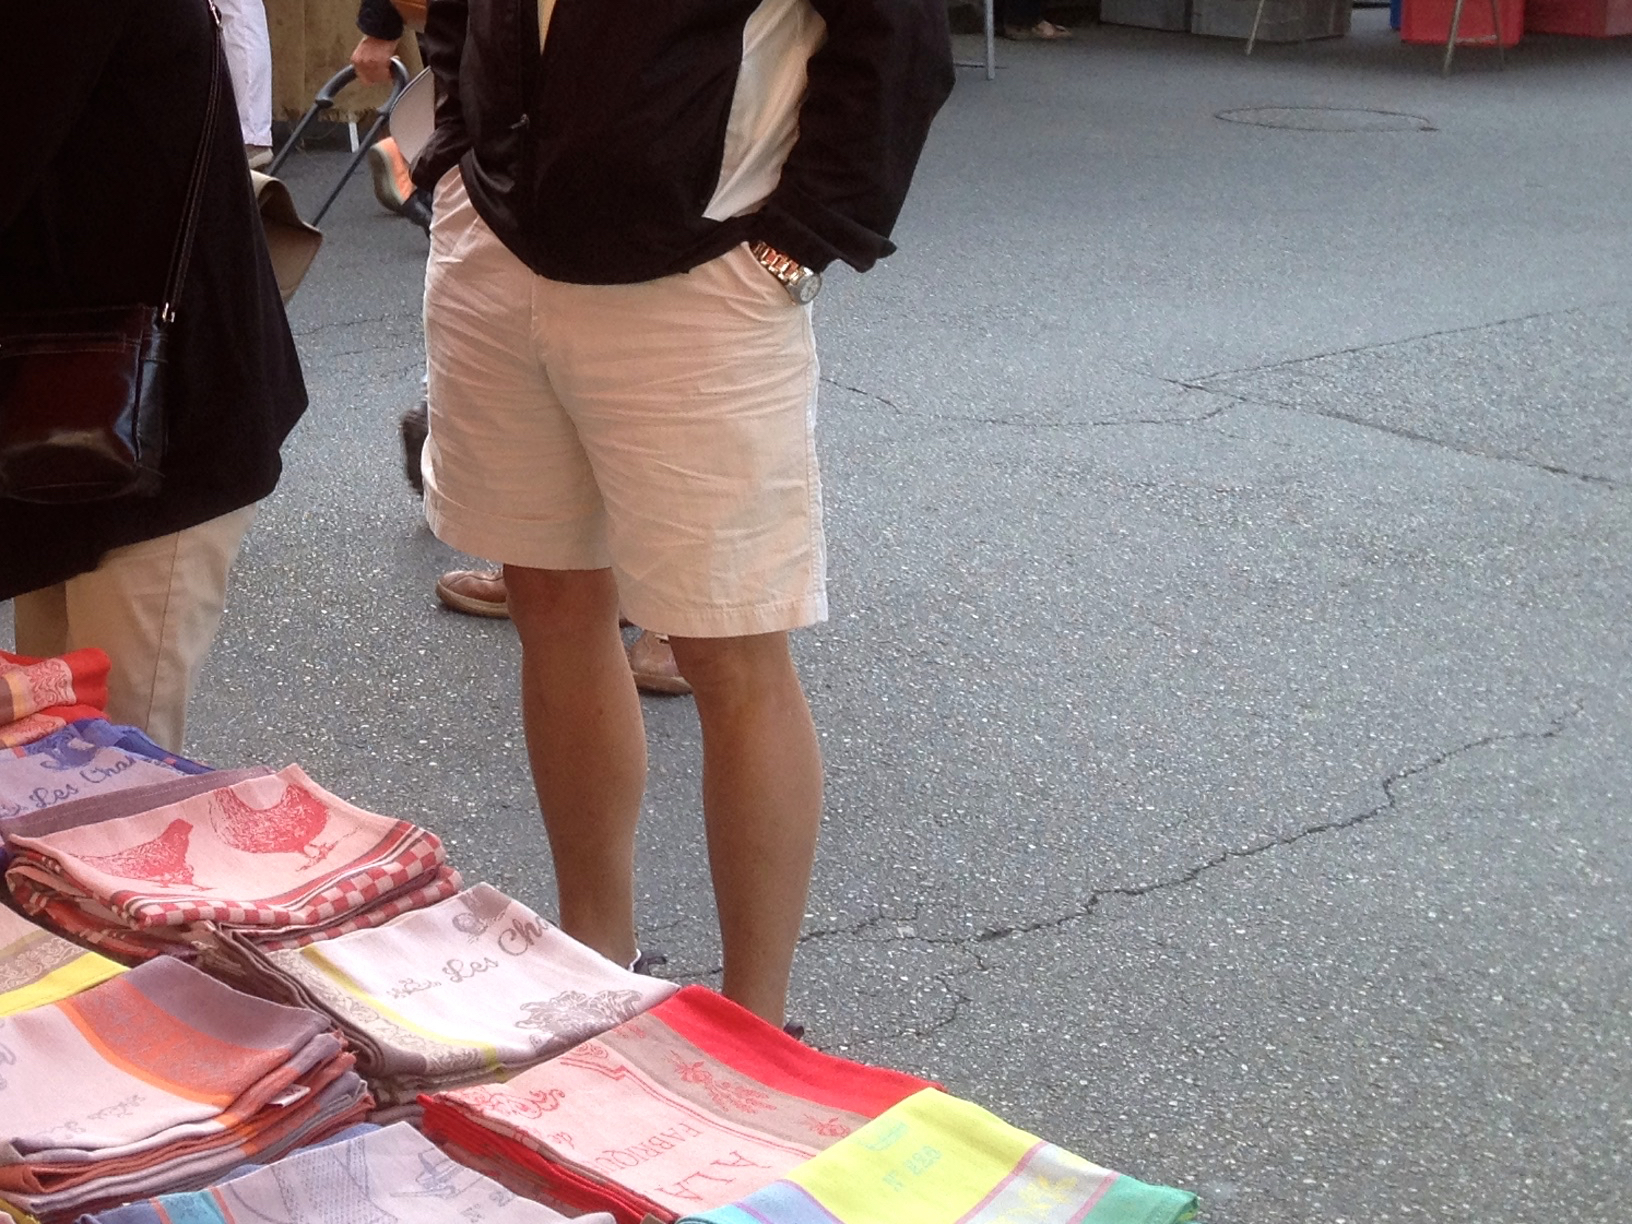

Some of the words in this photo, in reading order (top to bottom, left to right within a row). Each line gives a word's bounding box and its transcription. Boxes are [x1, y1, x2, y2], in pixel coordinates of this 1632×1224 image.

[29, 783, 79, 809] Les
[442, 957, 499, 983] Les
[654, 1171, 735, 1201] LA
